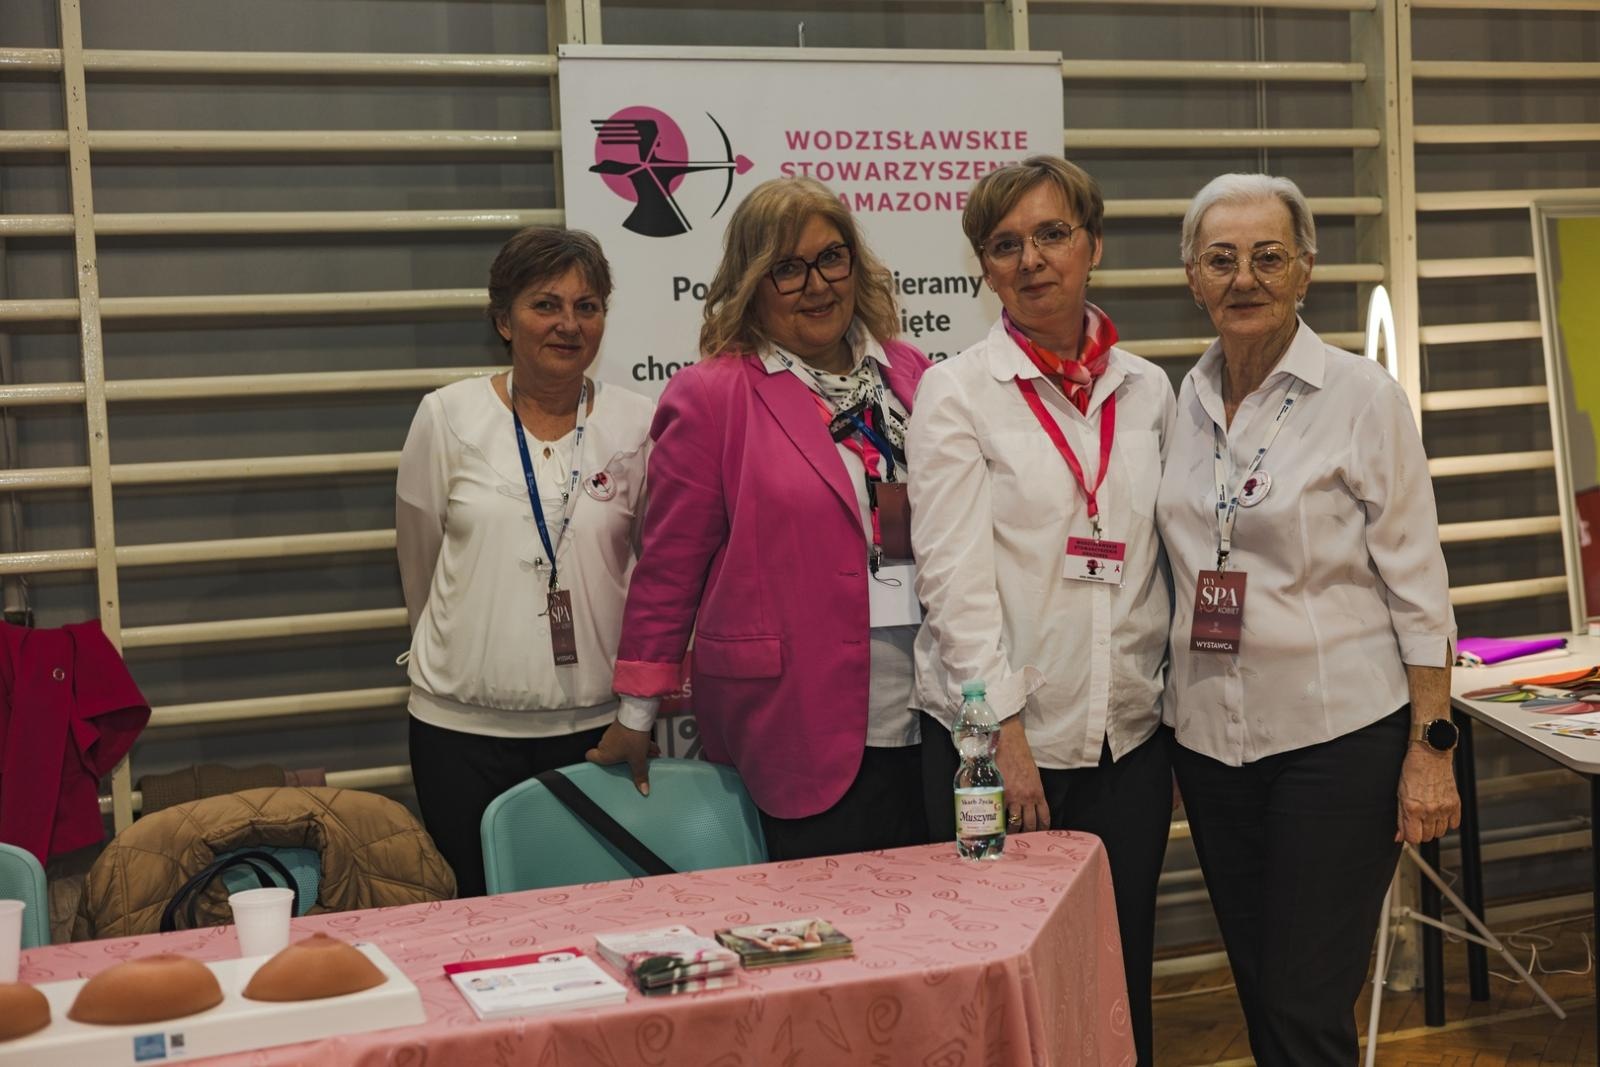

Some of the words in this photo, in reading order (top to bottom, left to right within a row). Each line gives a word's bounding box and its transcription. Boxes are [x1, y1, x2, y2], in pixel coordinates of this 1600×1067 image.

[785, 130, 1028, 151] WODZISŁAWSKIE
[779, 160, 1019, 182] STOWARZYSZE
[838, 191, 969, 212] AMAZONE
[673, 276, 709, 301] Po
[893, 271, 983, 298] ieramy
[901, 309, 951, 337] ięte
[632, 355, 695, 381] cho
[1200, 585, 1238, 607] SPA
[1196, 640, 1233, 650] WYSTAWCA
[960, 811, 997, 824] Muszyna
